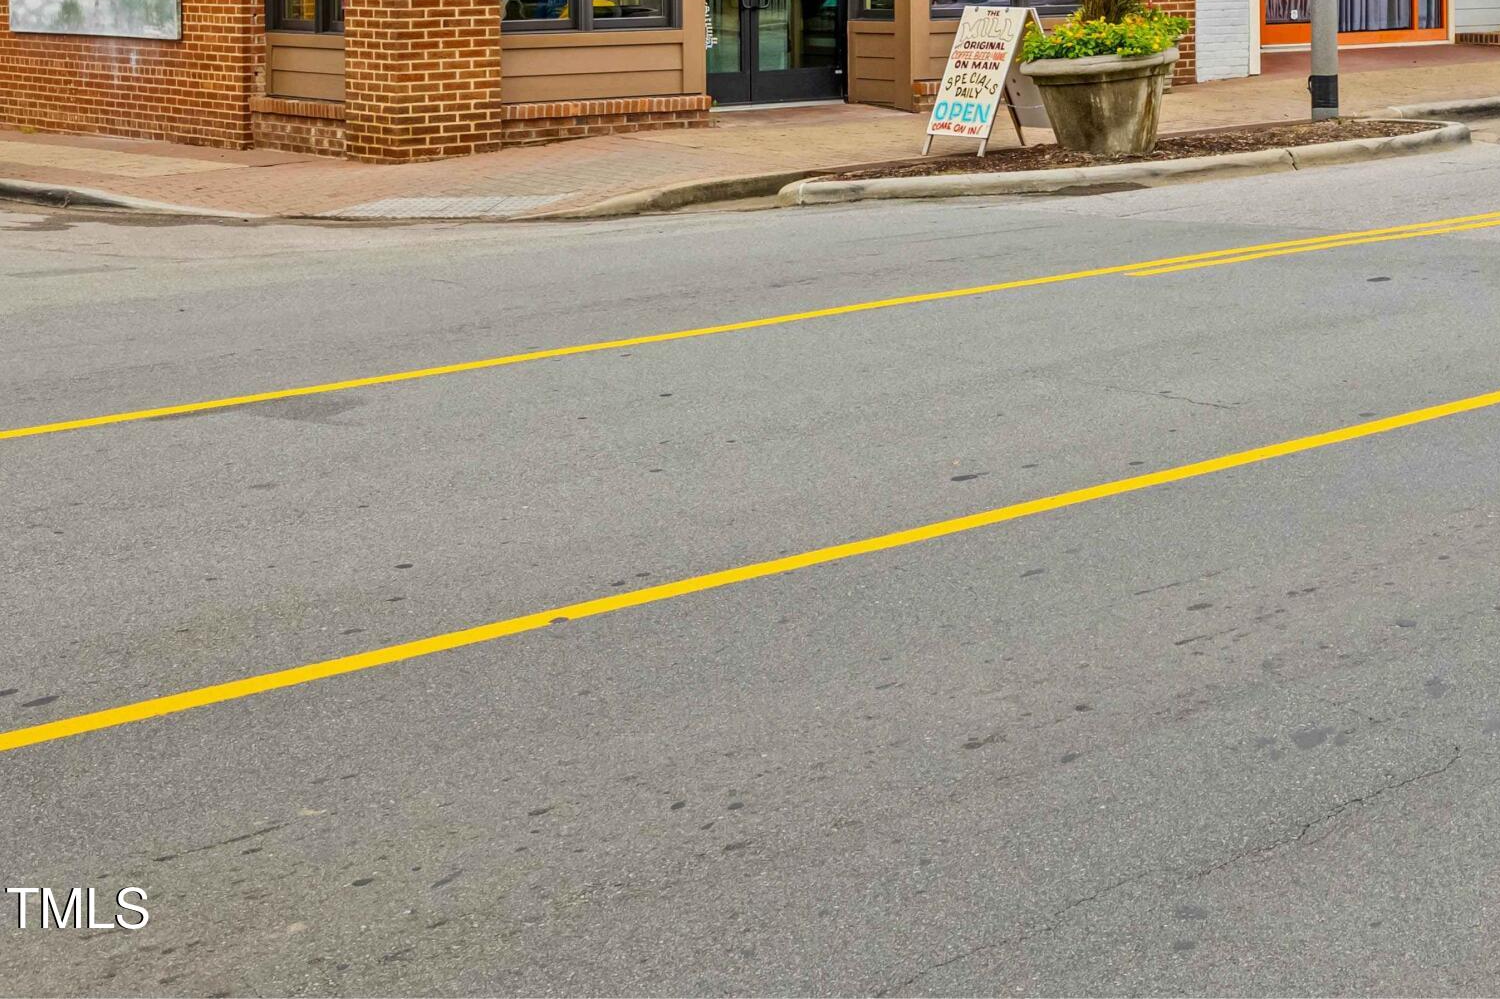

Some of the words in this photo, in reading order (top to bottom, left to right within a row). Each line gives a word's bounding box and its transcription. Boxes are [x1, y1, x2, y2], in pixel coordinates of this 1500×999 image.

[959, 16, 1015, 43] MILL
[963, 40, 1006, 51] ORIGINAL
[954, 60, 969, 69] ON
[971, 61, 1001, 70] MAIN
[945, 72, 999, 95] SPECIALS
[955, 86, 982, 99] DAILY
[934, 100, 991, 123] OPEN
[932, 122, 952, 131] COME
[953, 123, 966, 132] ON
[967, 125, 982, 135] IN!
